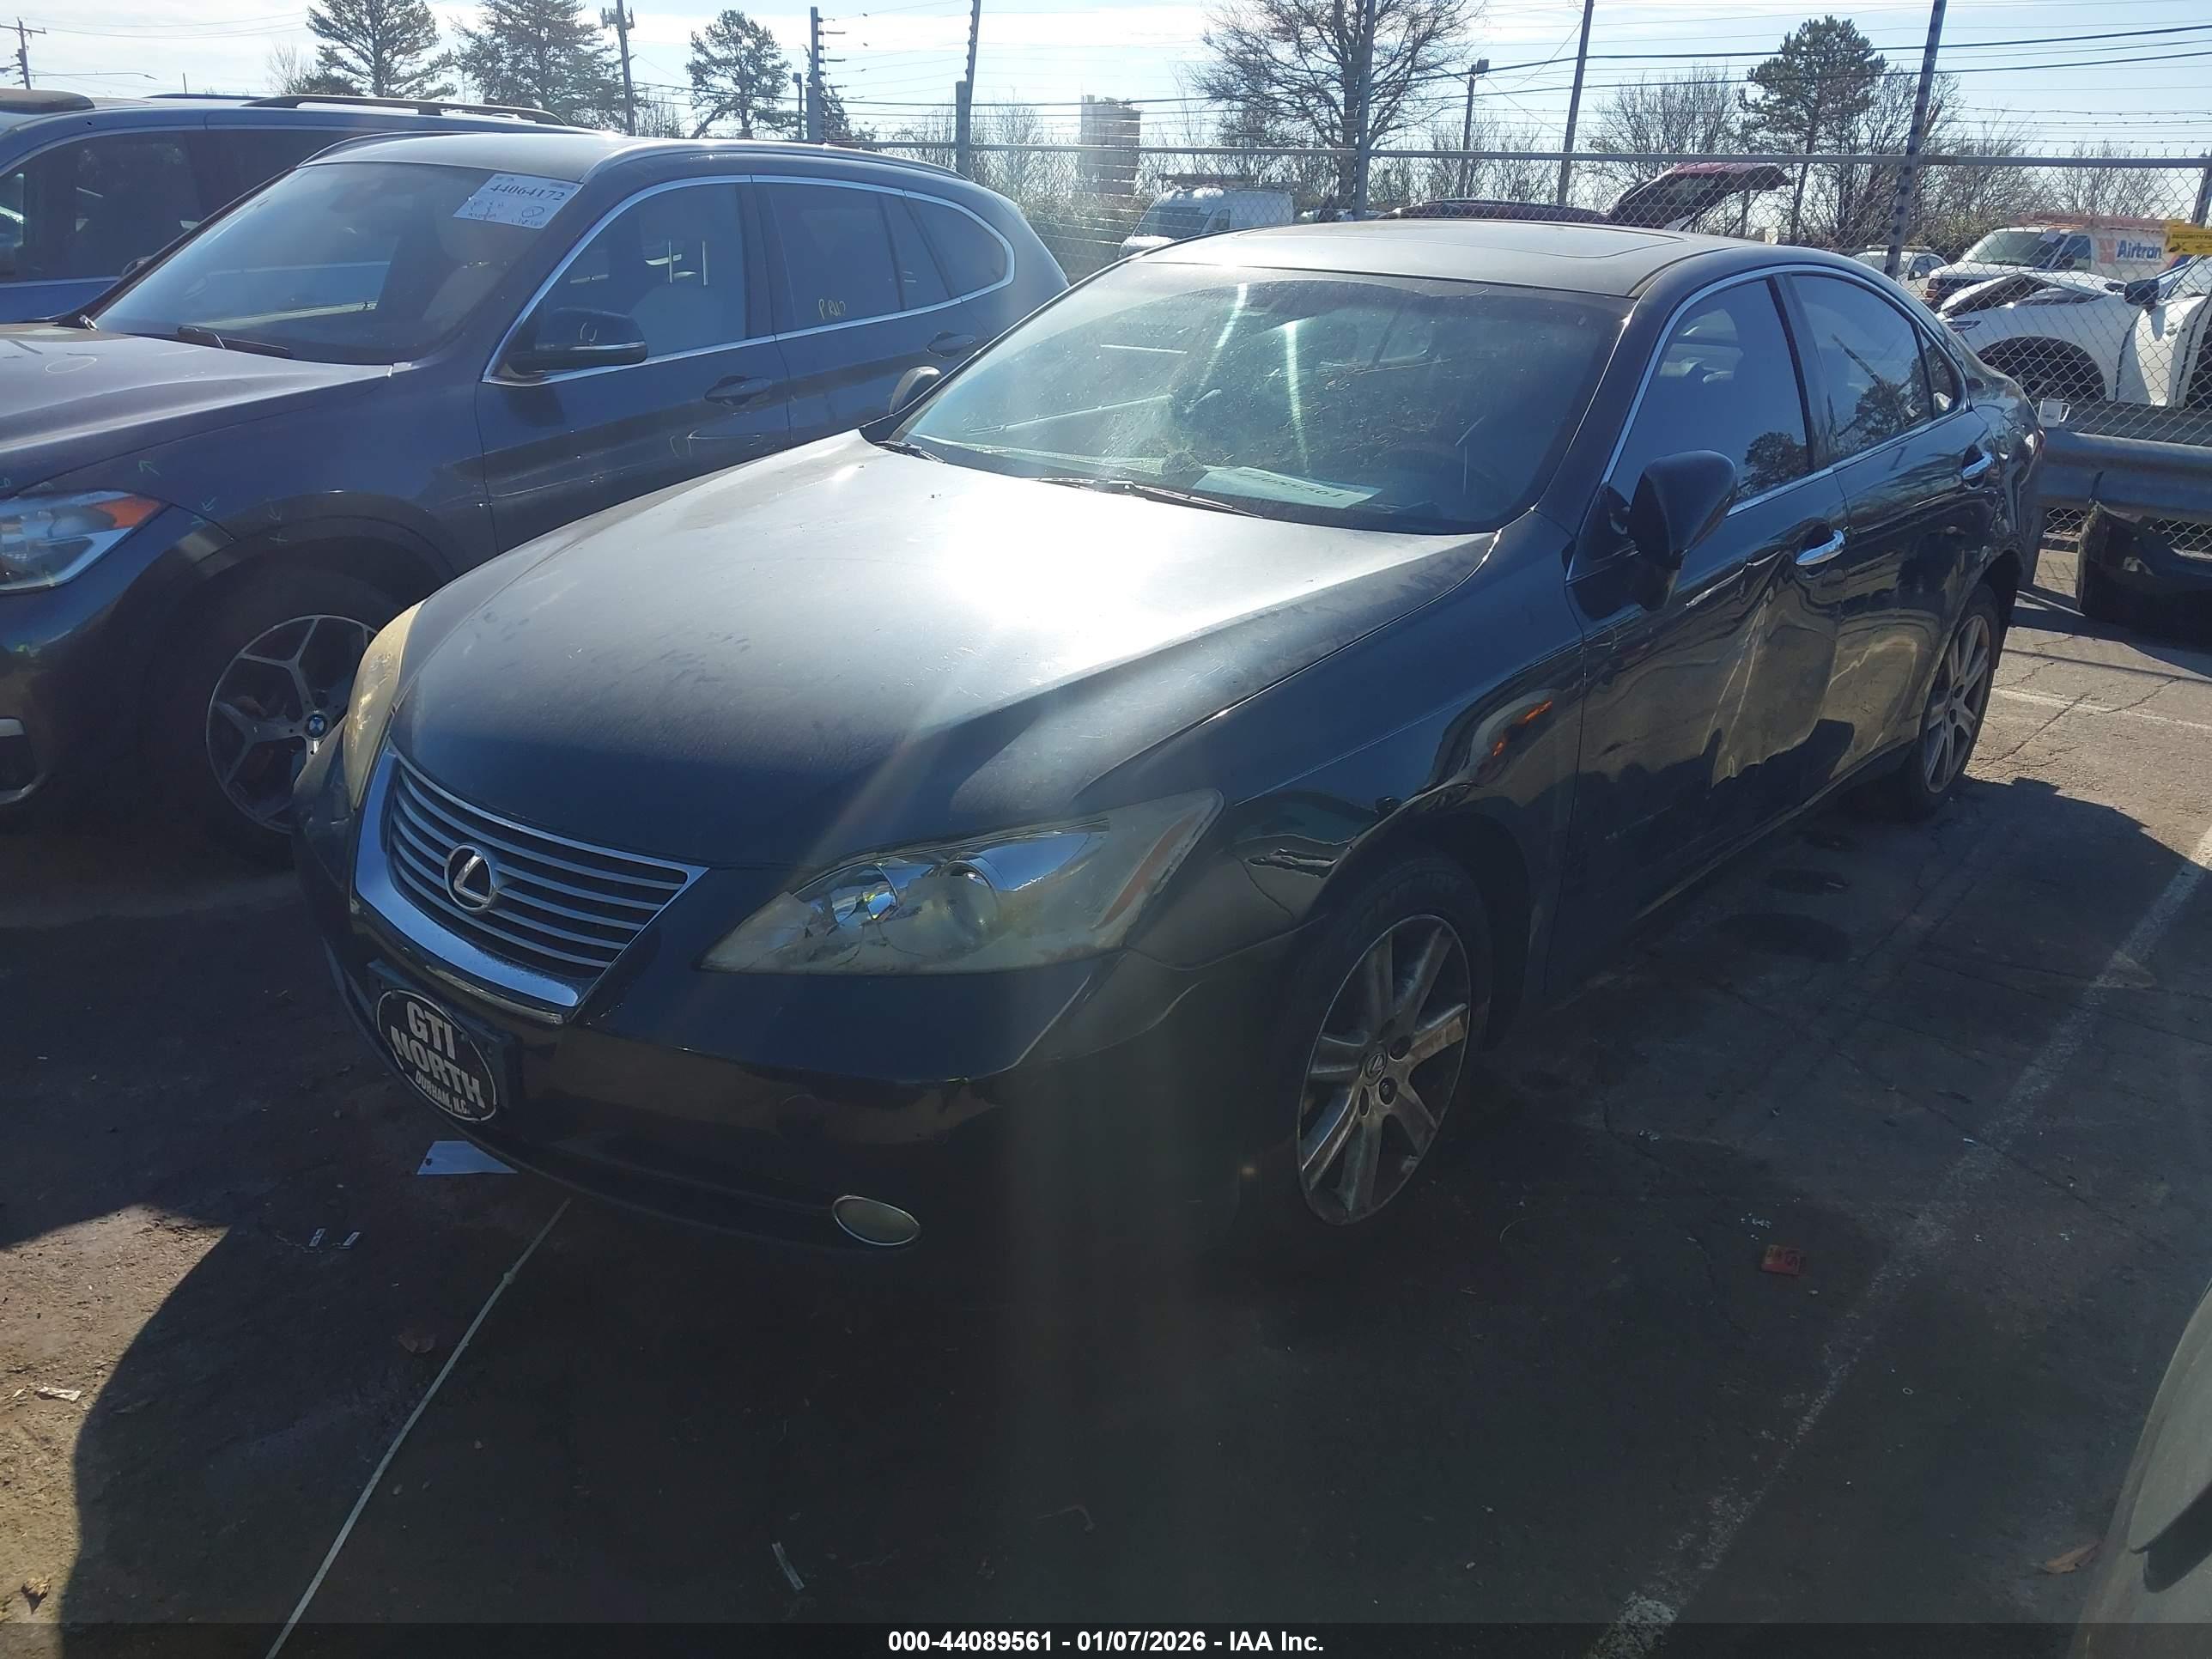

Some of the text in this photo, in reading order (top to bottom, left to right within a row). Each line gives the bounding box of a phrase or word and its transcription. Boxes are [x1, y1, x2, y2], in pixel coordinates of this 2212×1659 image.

[489, 183, 566, 201] 44064172
[406, 1001, 456, 1060] GTI
[390, 1025, 486, 1109] NORTH
